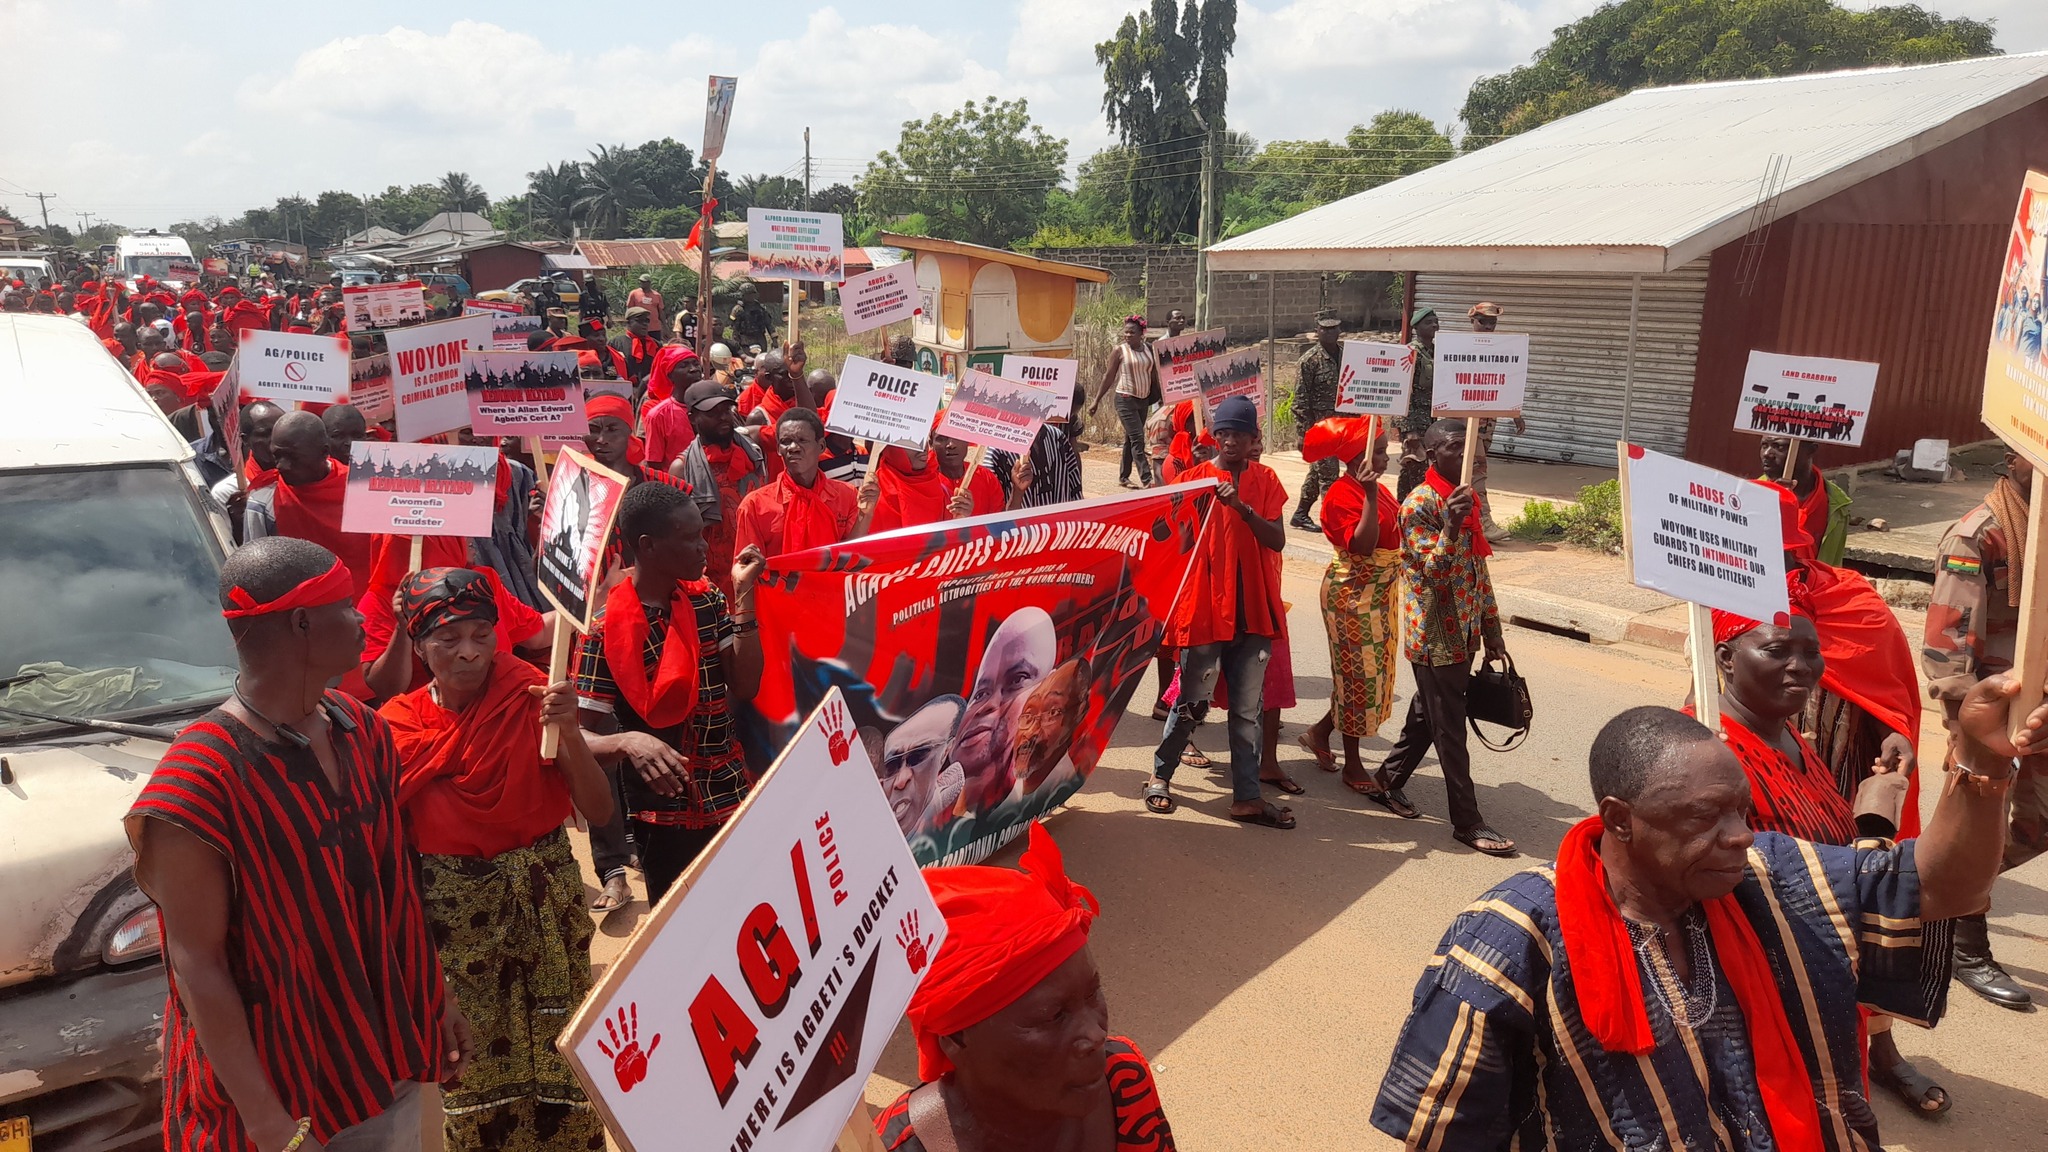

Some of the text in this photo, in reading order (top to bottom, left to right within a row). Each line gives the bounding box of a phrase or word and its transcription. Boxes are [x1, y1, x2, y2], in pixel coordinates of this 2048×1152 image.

[265, 348, 324, 362] AG/POLICE
[1366, 357, 1396, 366] LEGITIMATE
[1444, 354, 1476, 362] HEDIHOR
[1479, 355, 1509, 363] HLITABO
[414, 368, 458, 387] IS A COMMON
[1021, 366, 1059, 380] POLICE
[1456, 373, 1505, 385] YOUR GAZETTE IS
[1782, 370, 1837, 382] LAND GRABBING
[401, 389, 435, 405] CRIMINAL
[436, 384, 448, 396] AND
[867, 372, 919, 397] POLICE
[874, 391, 906, 403] COMPLICITY
[1462, 390, 1498, 401] FRAUDULENT
[1792, 403, 1820, 412] WOYOME
[495, 415, 527, 423] Agbeti's
[950, 412, 964, 420] Who
[980, 421, 995, 429] your
[996, 424, 1012, 432] mate
[949, 420, 976, 432] Training,
[979, 427, 993, 435] UCC
[1007, 434, 1028, 444] Legon.
[391, 498, 442, 506] Awomefia
[1690, 482, 1725, 505] ABUSE
[1668, 493, 1748, 526] OF MILITARY POWER
[394, 517, 442, 526] fraudster
[1661, 518, 1757, 558] WOYOME USES MILITARY
[916, 535, 994, 579] CHIEFS
[994, 523, 1051, 562] STAND
[1050, 521, 1106, 551] UNITED
[1653, 532, 1766, 576] GUARDS TO INTIMIDATE OUR
[1667, 552, 1756, 589] CHIEFS AND CITIZENS!
[893, 595, 935, 625] POLITICAL
[939, 580, 992, 604] AUTHORITIES
[995, 579, 1007, 589] BY
[1008, 577, 1024, 587] THE
[1056, 572, 1095, 586] BROTHERS
[815, 810, 848, 907] POLICE
[688, 838, 822, 1110] AG/
[775, 1051, 797, 1087] IS
[853, 864, 899, 948] DOCKET
